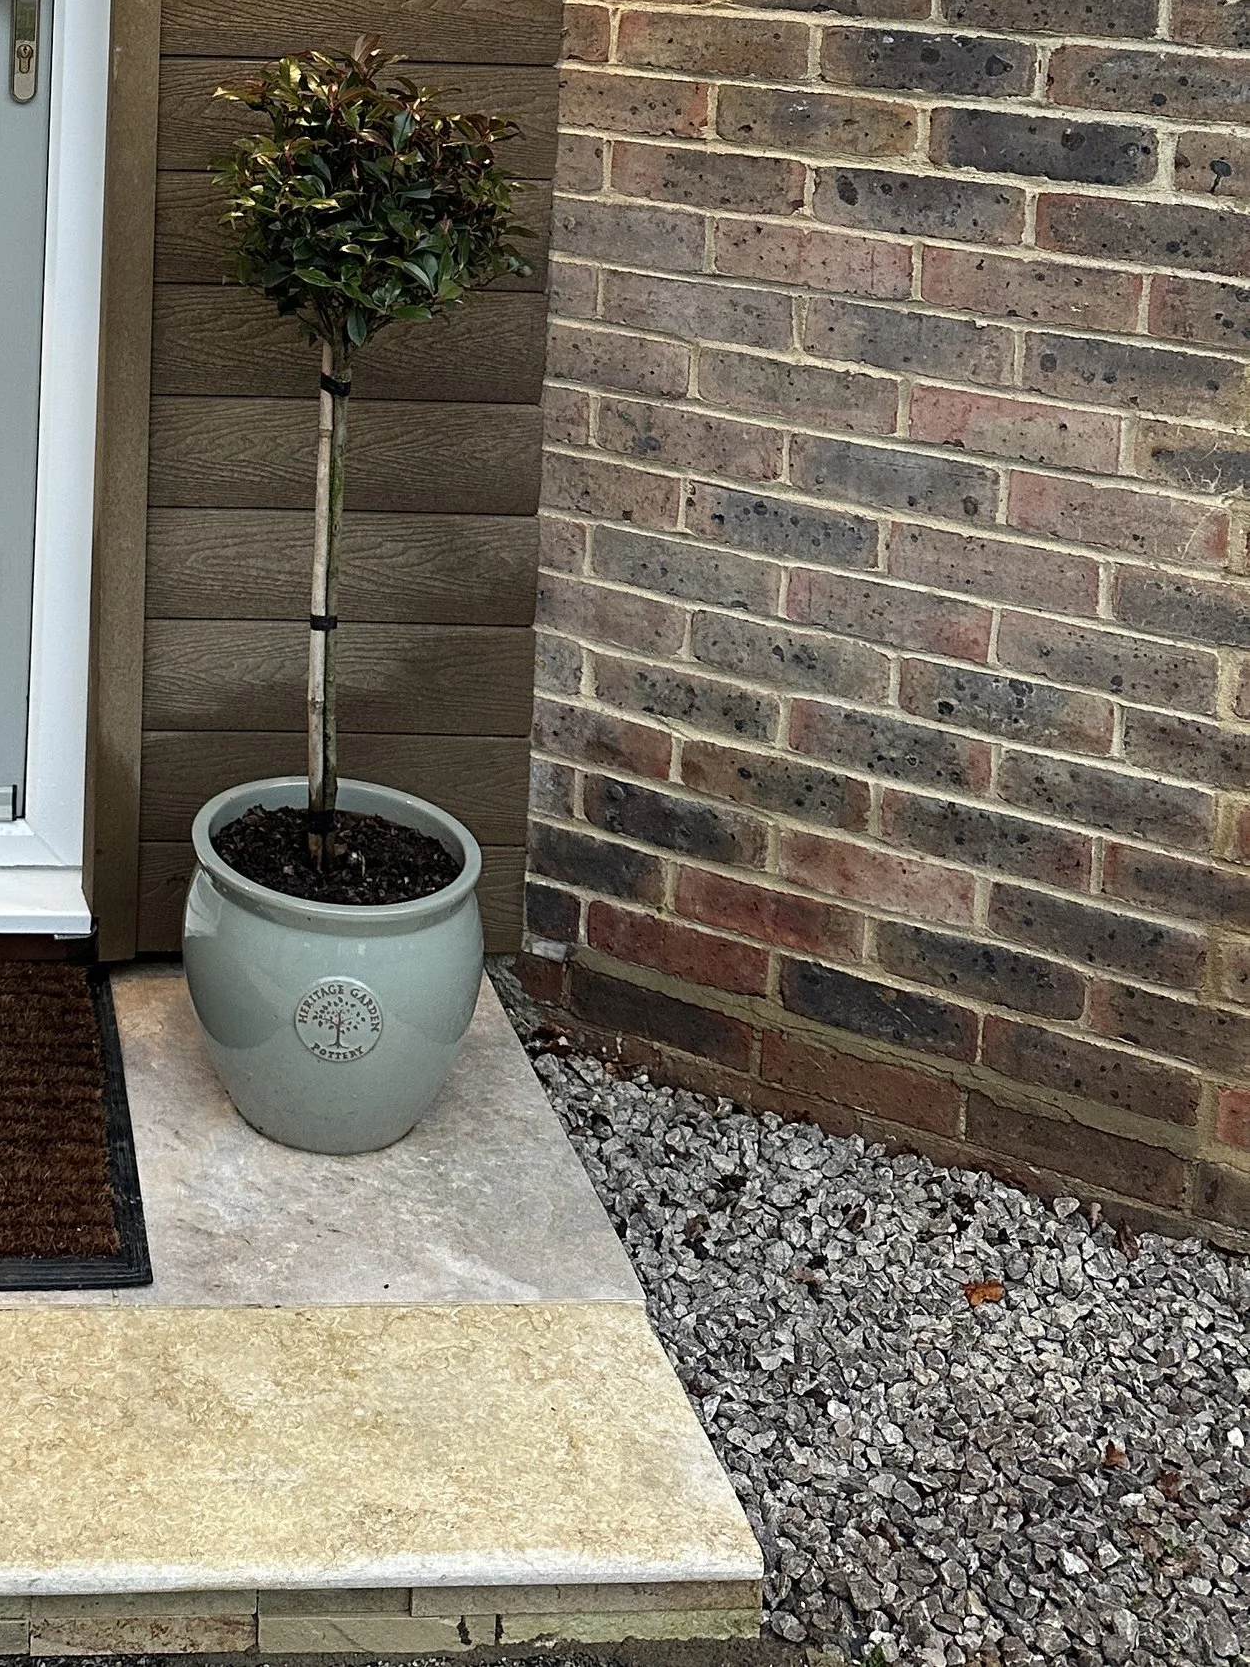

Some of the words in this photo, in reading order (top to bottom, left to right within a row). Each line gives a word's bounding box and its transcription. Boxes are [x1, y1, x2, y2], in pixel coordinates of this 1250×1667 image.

[298, 984, 345, 1024] HERITAGE
[350, 988, 380, 1032] GARDEN
[310, 1042, 364, 1060] POTTERY
